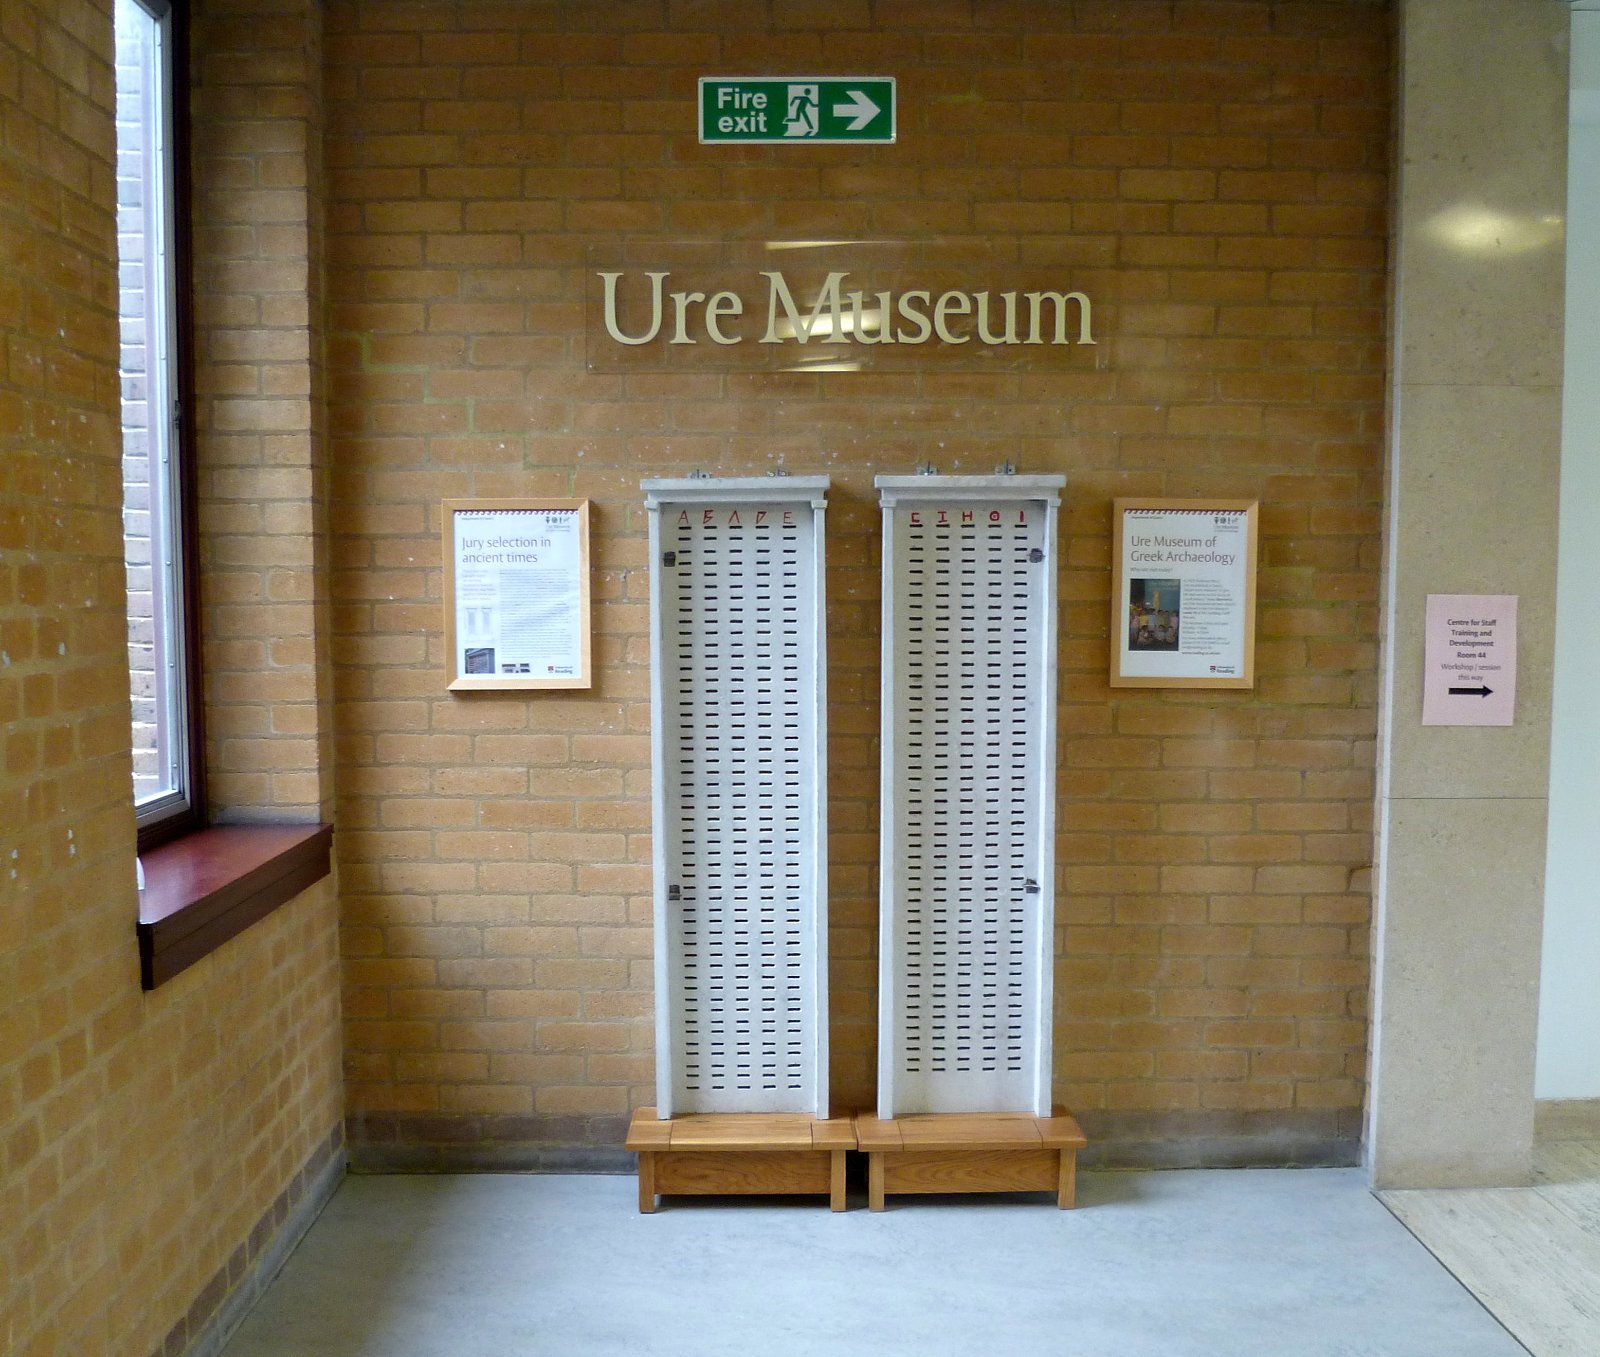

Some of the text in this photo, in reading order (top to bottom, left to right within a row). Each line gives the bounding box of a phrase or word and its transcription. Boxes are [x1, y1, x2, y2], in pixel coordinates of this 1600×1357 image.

[717, 87, 768, 110] Fire
[717, 111, 768, 133] exit
[597, 271, 1098, 346] Ure Museum
[462, 536, 551, 550] Jury selection in
[1131, 535, 1218, 548] Ure Museum of
[462, 552, 538, 563] ancient times
[1130, 550, 1236, 566] Greek Archaeology
[1449, 640, 1494, 648] Development
